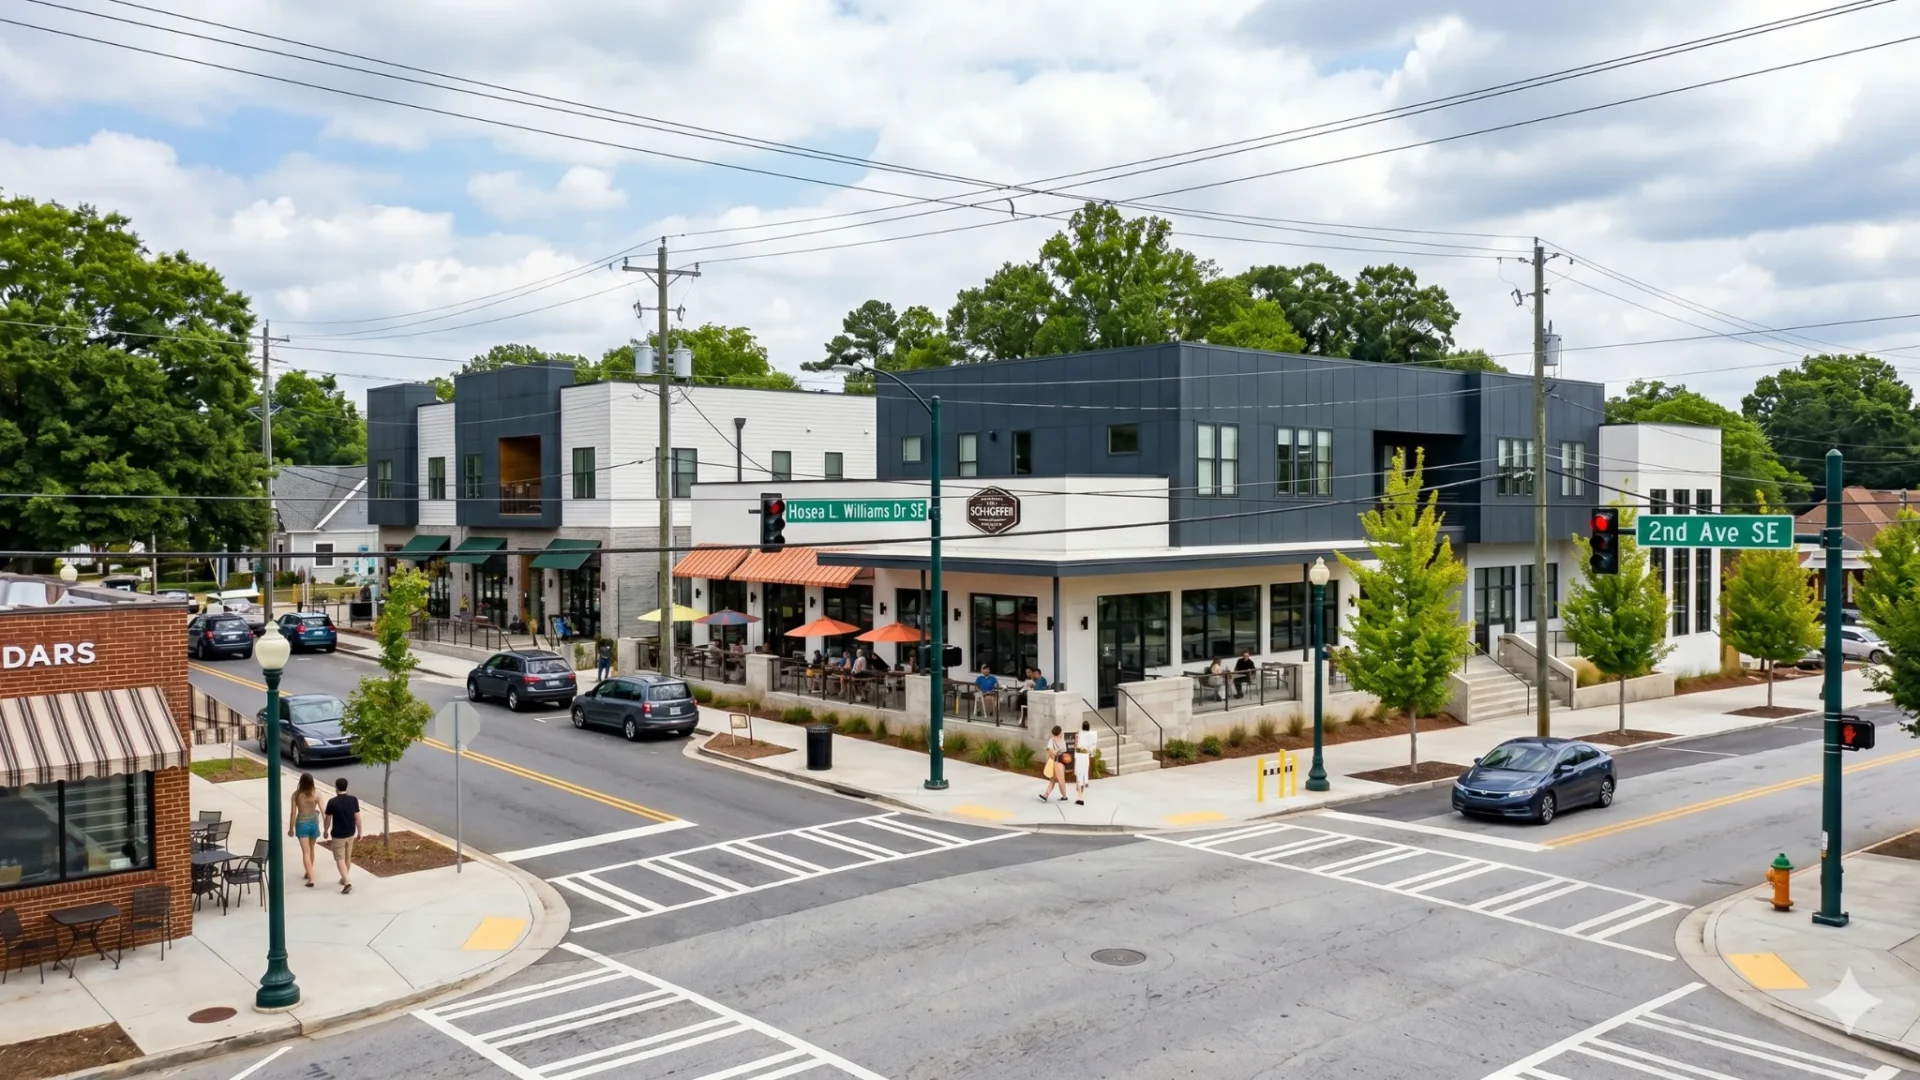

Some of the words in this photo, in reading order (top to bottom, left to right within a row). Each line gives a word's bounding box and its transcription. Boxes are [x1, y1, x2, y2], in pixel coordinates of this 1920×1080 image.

[788, 503, 825, 519] Hosea
[829, 503, 839, 519] L.
[843, 503, 890, 519] Williams
[893, 503, 907, 518] Dr
[910, 502, 924, 518] SE
[1648, 521, 1687, 542] 2nd
[1700, 521, 1739, 543] Ave
[1751, 521, 1779, 543] SE
[2, 642, 96, 669] DARS
